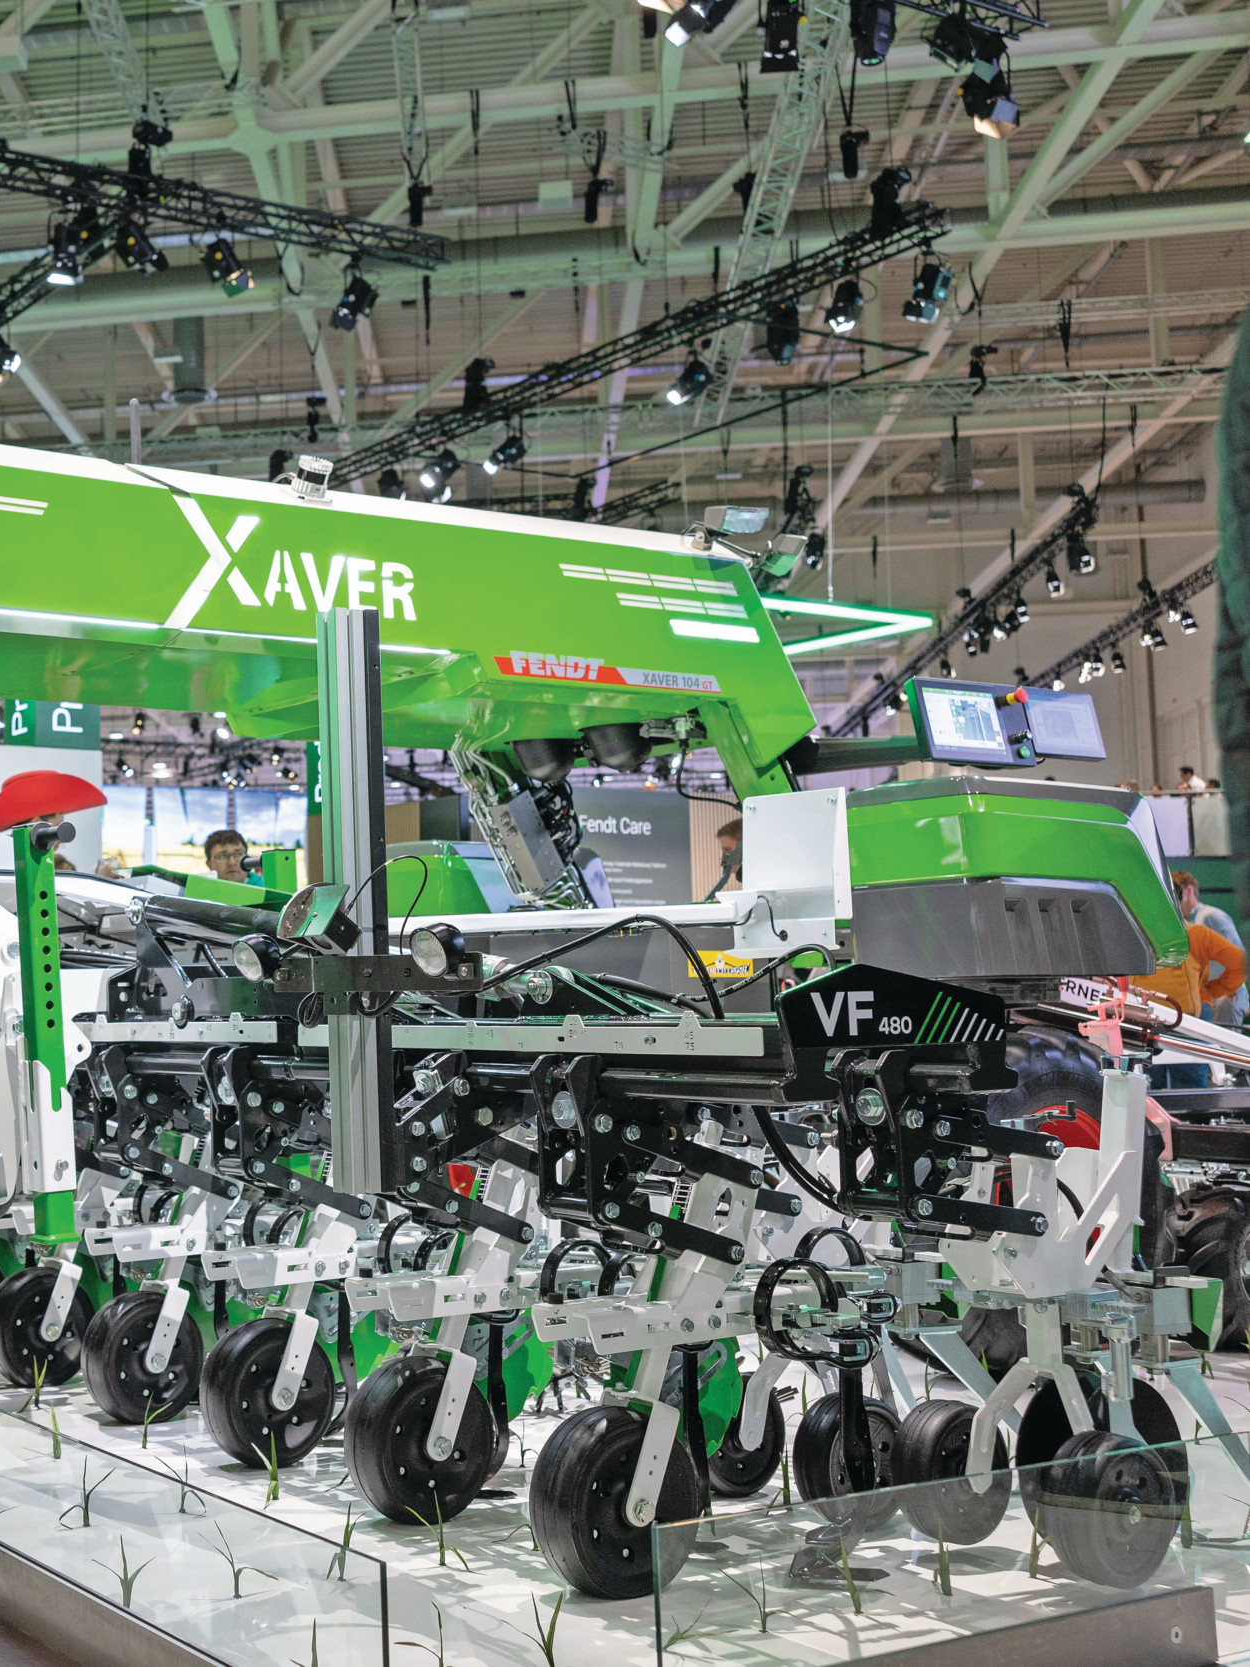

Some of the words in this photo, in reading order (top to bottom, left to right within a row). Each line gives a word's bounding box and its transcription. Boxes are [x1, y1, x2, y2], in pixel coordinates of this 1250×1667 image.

[164, 494, 417, 628] XAVER
[510, 650, 604, 680] FENDT
[643, 672, 679, 688] XAVER
[681, 676, 700, 689] 104
[702, 680, 713, 690] GT
[578, 815, 617, 834] Fendt
[619, 817, 652, 835] Care
[810, 991, 874, 1037] VF
[878, 1016, 913, 1035] 480
